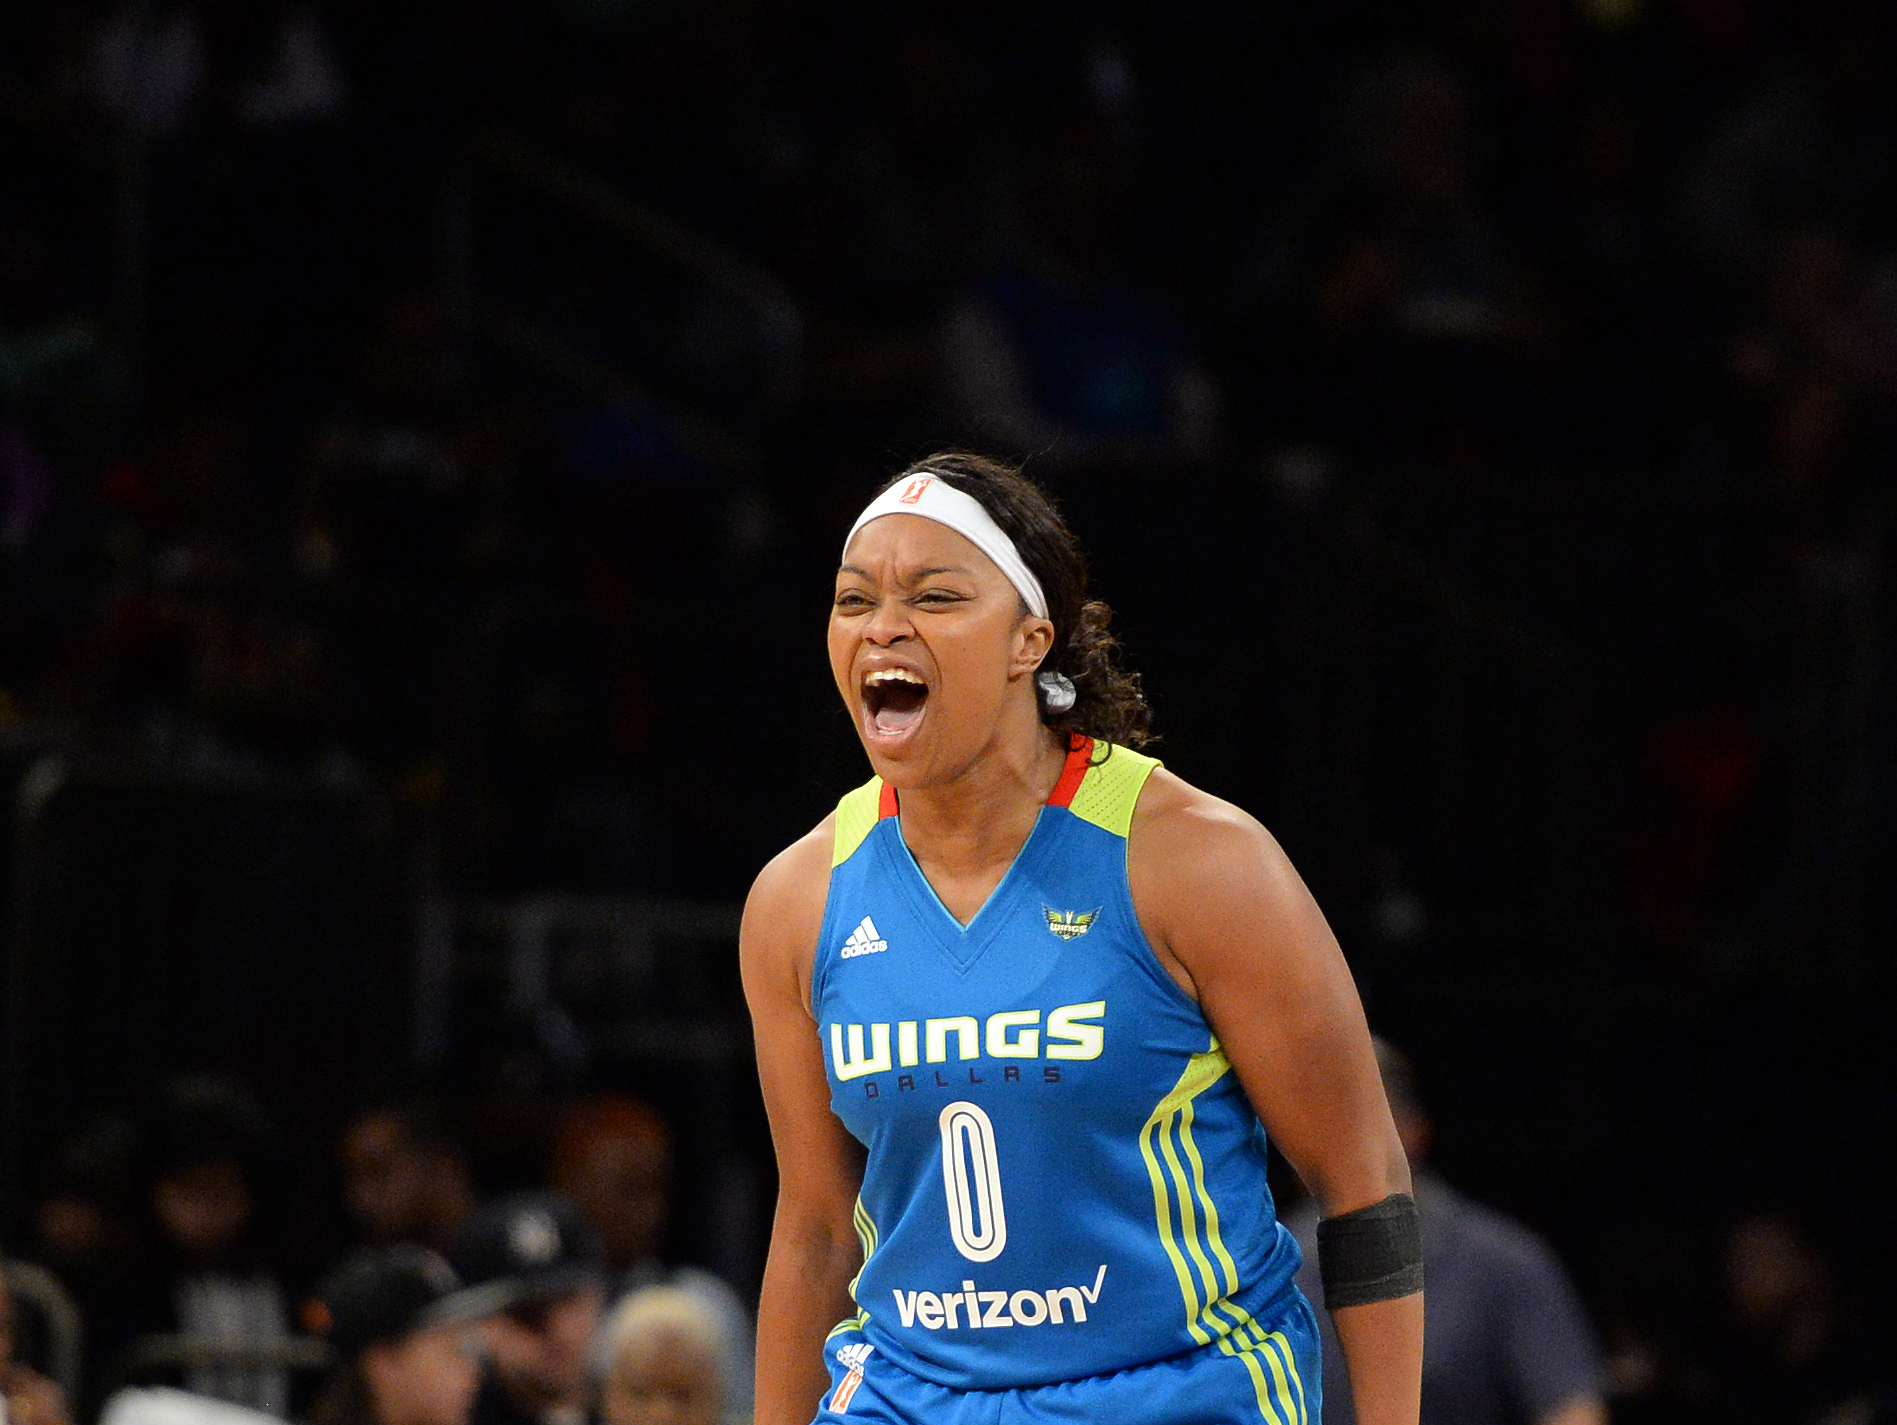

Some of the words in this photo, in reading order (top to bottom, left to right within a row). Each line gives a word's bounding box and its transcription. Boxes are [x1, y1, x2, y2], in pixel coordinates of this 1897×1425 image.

[840, 938, 888, 960] adidas
[830, 1000, 1106, 1082] WINGS
[864, 1065, 1062, 1099] DALLAS
[939, 1101, 1007, 1262] 0
[893, 1279, 1088, 1330] verizon
